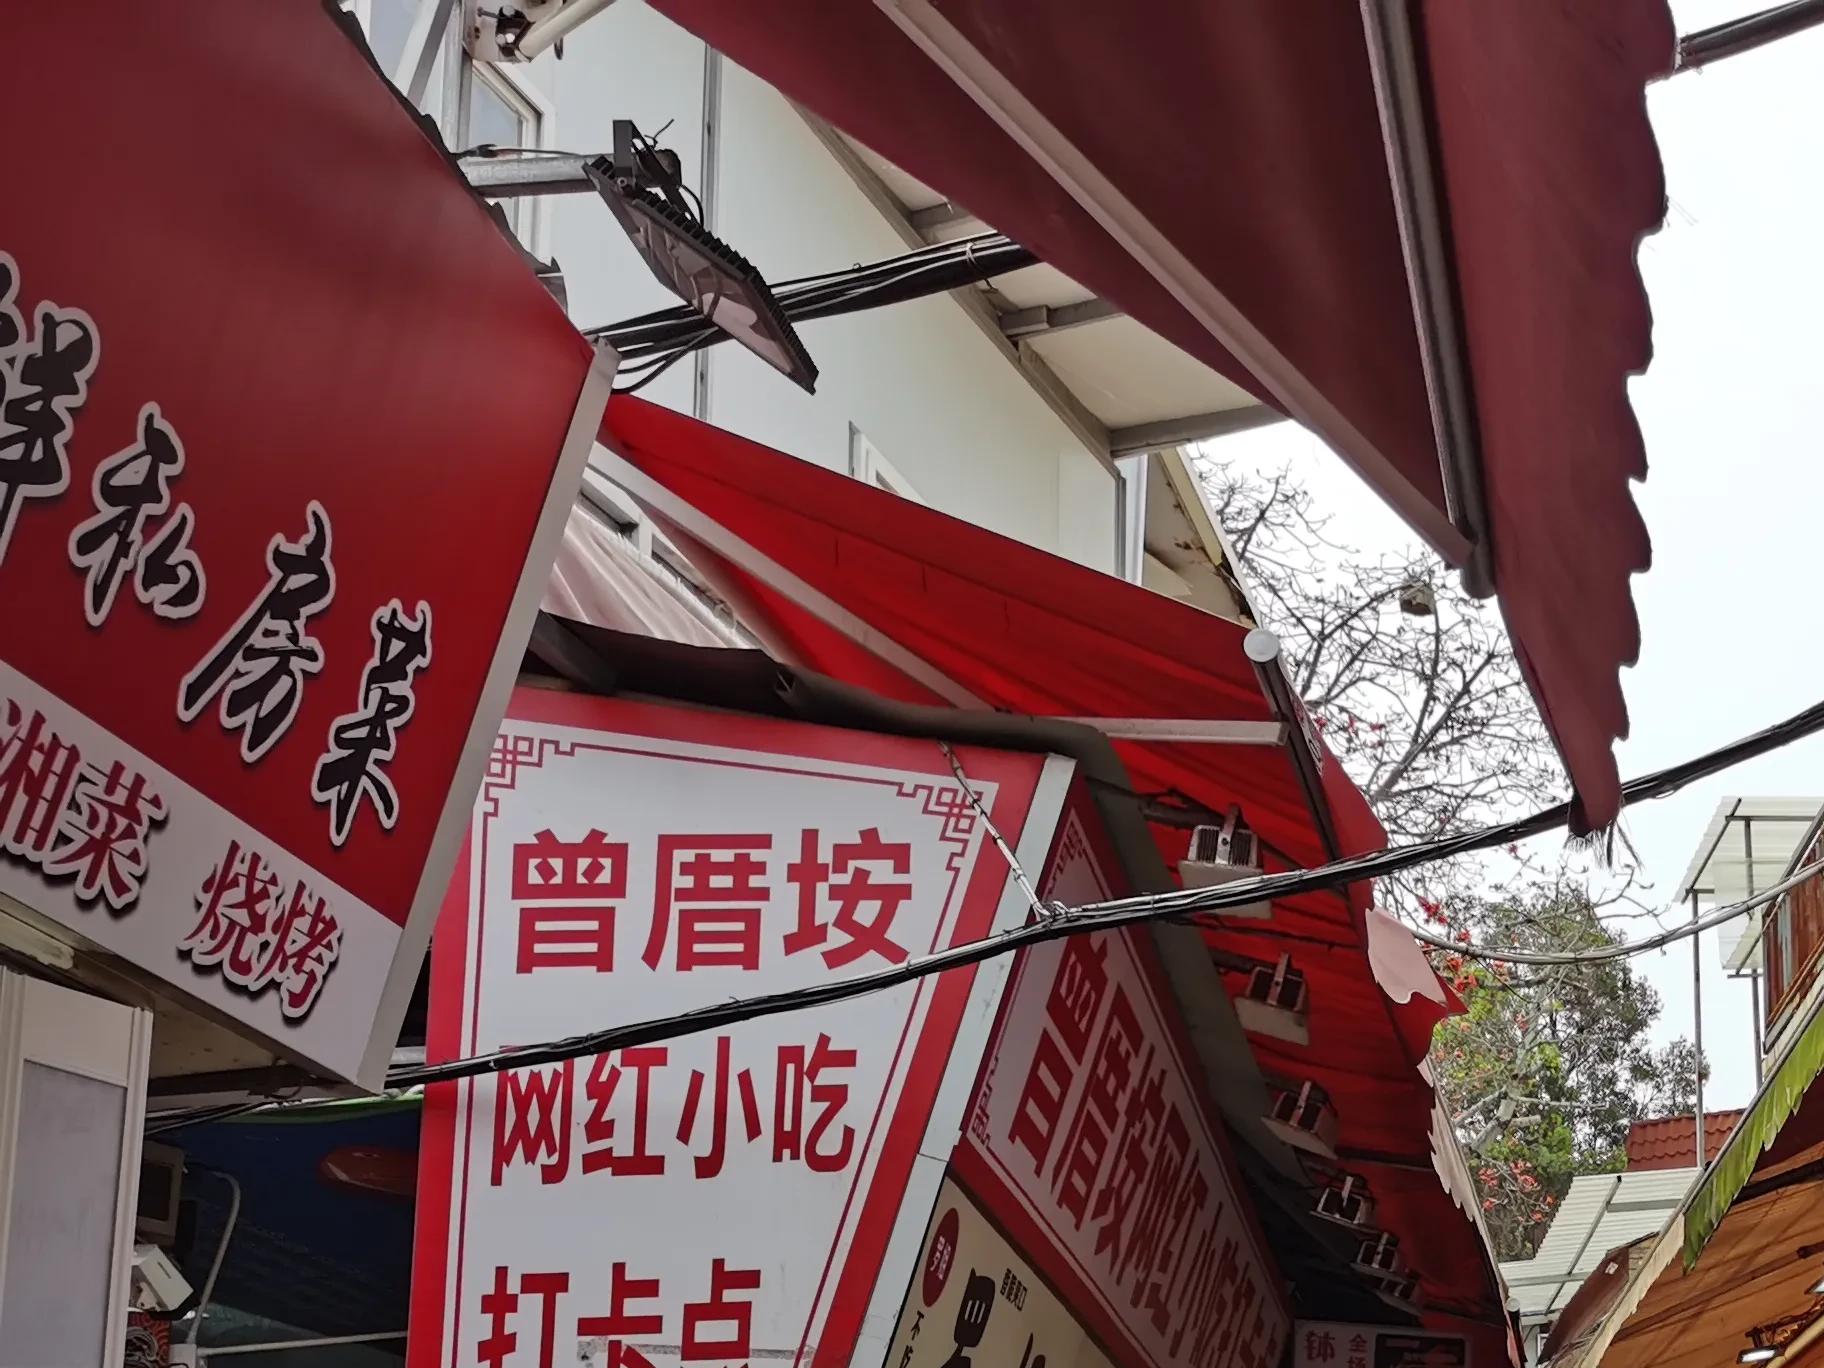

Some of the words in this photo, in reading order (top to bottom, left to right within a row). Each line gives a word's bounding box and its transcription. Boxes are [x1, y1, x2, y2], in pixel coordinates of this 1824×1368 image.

[184, 842, 342, 1018] 烧烤
[512, 827, 915, 974] 曾厝垵
[491, 1034, 859, 1186] 网红小吃
